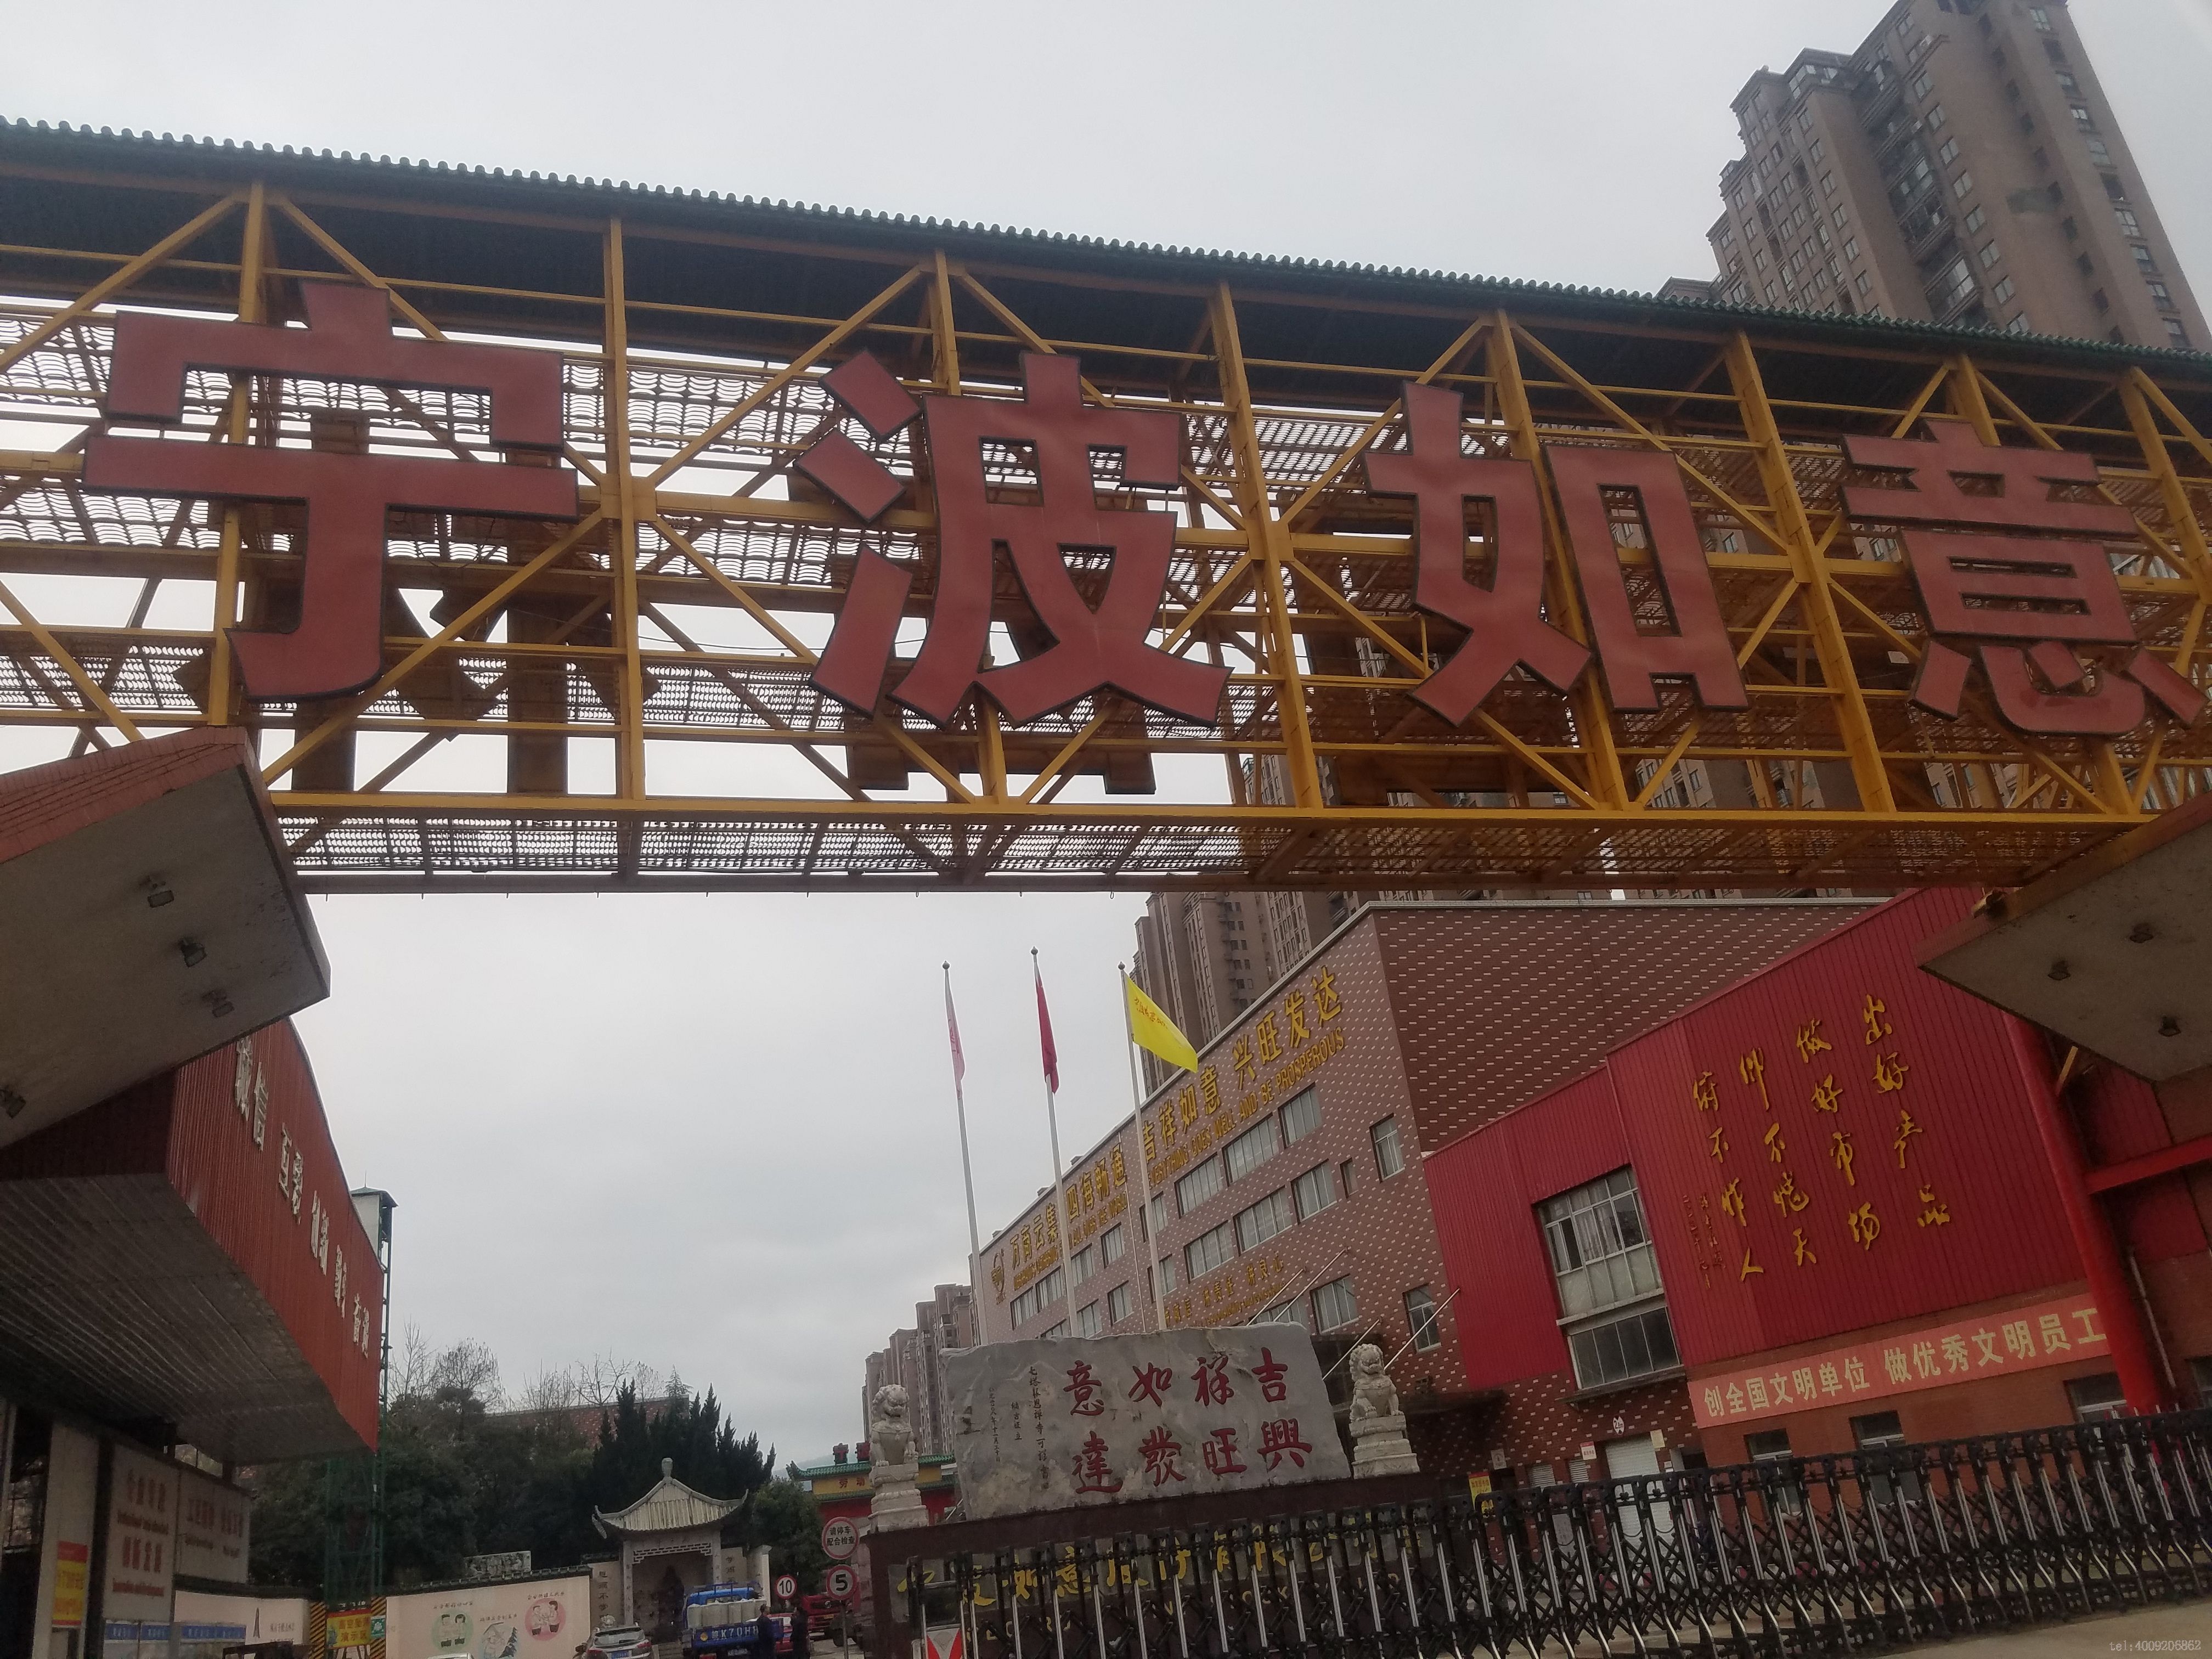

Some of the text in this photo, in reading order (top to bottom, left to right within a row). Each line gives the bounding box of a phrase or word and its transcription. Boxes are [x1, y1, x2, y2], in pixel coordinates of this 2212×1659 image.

[82, 279, 2209, 735] 宁波如意
[1010, 964, 1342, 1269] 万商云集 四海畅通 吉祥如意 兴旺发达
[1192, 1127, 1212, 1155] GOES
[1213, 1110, 1235, 1143] WELL
[1238, 1096, 1257, 1125] AND
[1261, 1085, 1275, 1108] BE
[1276, 1028, 1345, 1096] PROSPEROUS
[1064, 1346, 1289, 1417] 吉祥如意
[1703, 1307, 2107, 1418] 创全国文明单位 做优秀文明员工
[826, 1536, 855, 1546] 配合检查
[829, 1525, 851, 1536] 请停车
[778, 1579, 793, 1594] 10
[835, 1574, 848, 1591] 5
